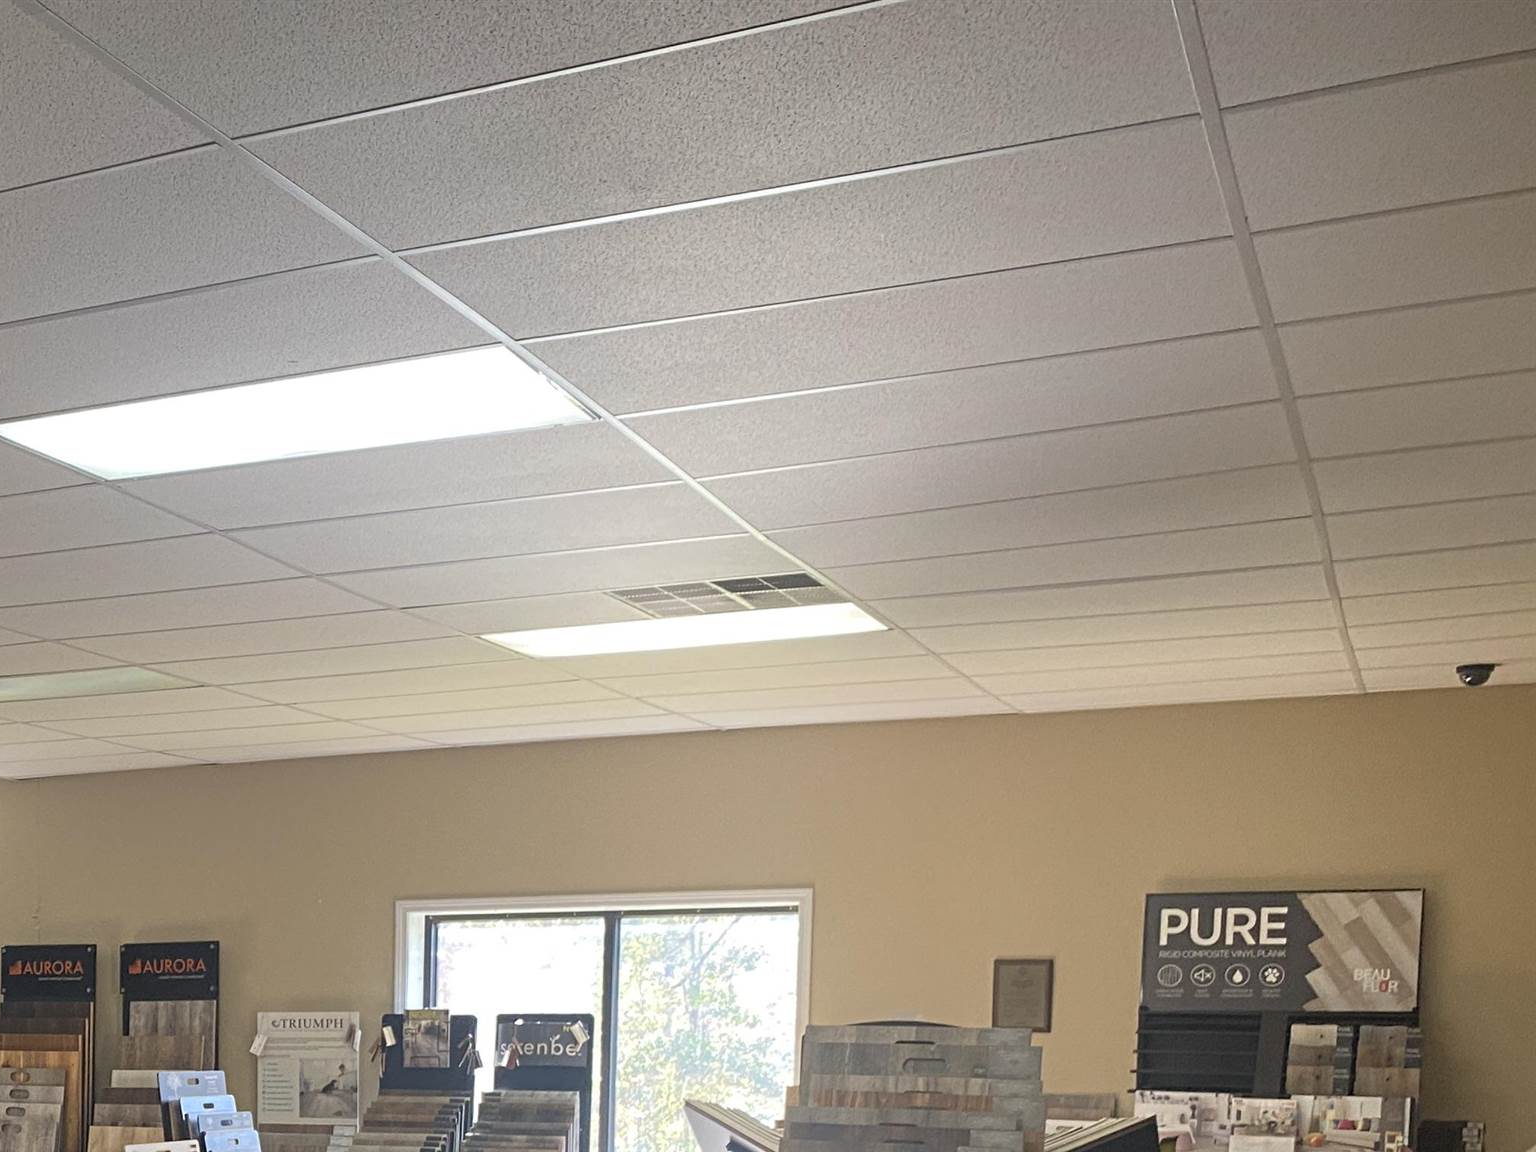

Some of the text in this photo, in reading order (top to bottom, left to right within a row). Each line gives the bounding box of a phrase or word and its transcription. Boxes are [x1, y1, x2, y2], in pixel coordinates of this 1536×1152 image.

[1159, 907, 1288, 946] PURE
[1159, 950, 1287, 959] RIGID COMPOSITE VINYL PLANK
[23, 960, 84, 975] AURORA
[144, 958, 207, 973] AURORA
[1353, 968, 1391, 982] BEAU
[279, 1018, 344, 1029] TRIUMPH
